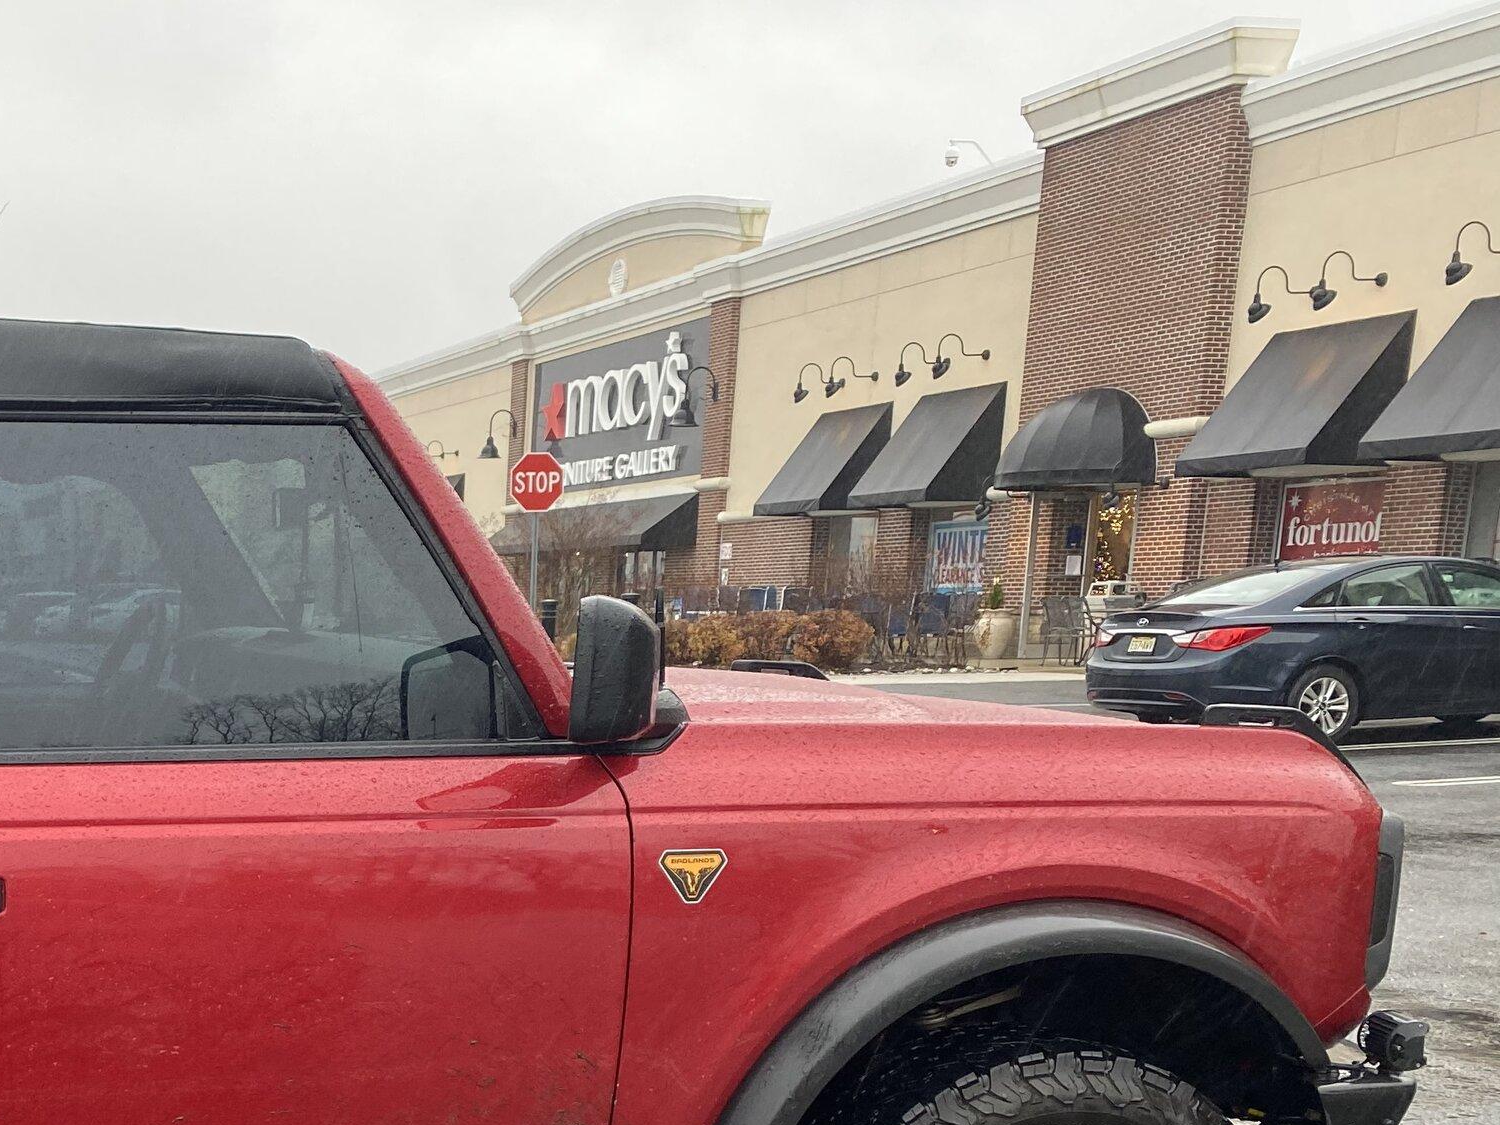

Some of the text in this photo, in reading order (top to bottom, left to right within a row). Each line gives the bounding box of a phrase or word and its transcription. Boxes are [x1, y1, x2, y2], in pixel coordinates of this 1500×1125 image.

[564, 331, 690, 442] macy's
[614, 444, 678, 480] GALLERY
[514, 470, 561, 494] STOP
